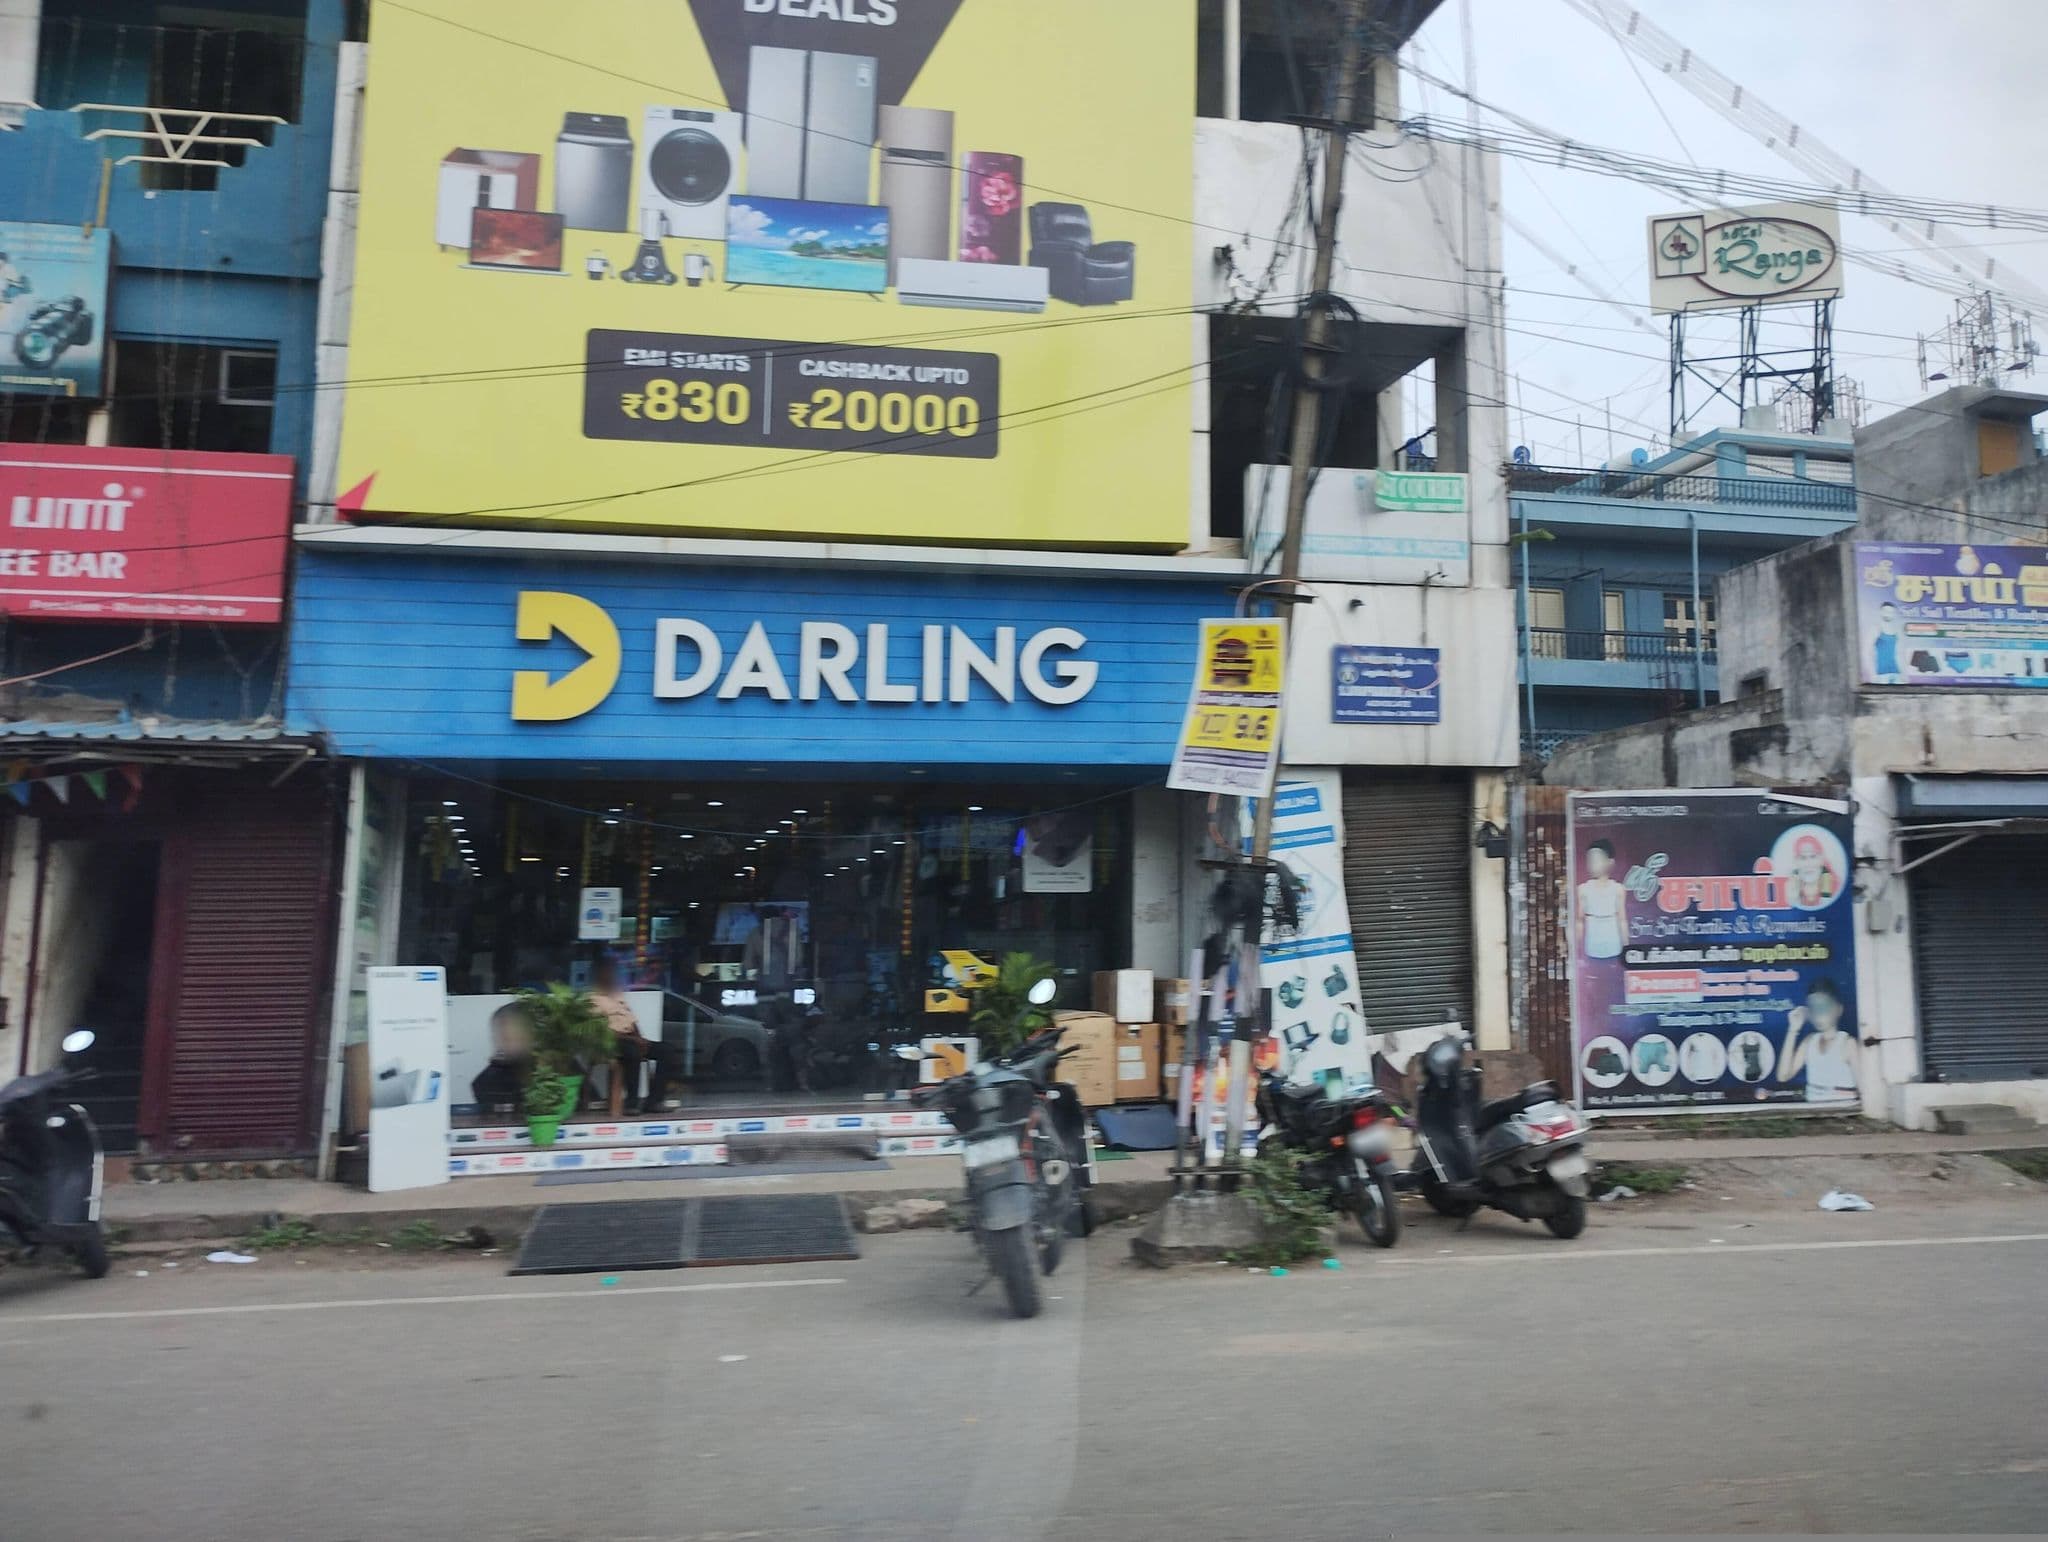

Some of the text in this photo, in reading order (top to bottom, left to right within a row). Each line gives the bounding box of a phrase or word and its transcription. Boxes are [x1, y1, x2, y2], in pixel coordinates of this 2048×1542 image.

[1713, 239, 1823, 284] Ranga
[623, 348, 751, 373] EMI STARTS
[799, 359, 970, 385] CASHBACK UPTO
[621, 378, 751, 425] ₹830
[788, 389, 980, 437] ₹20000
[48, 549, 128, 579] BAR
[653, 616, 1099, 705] DARLING
